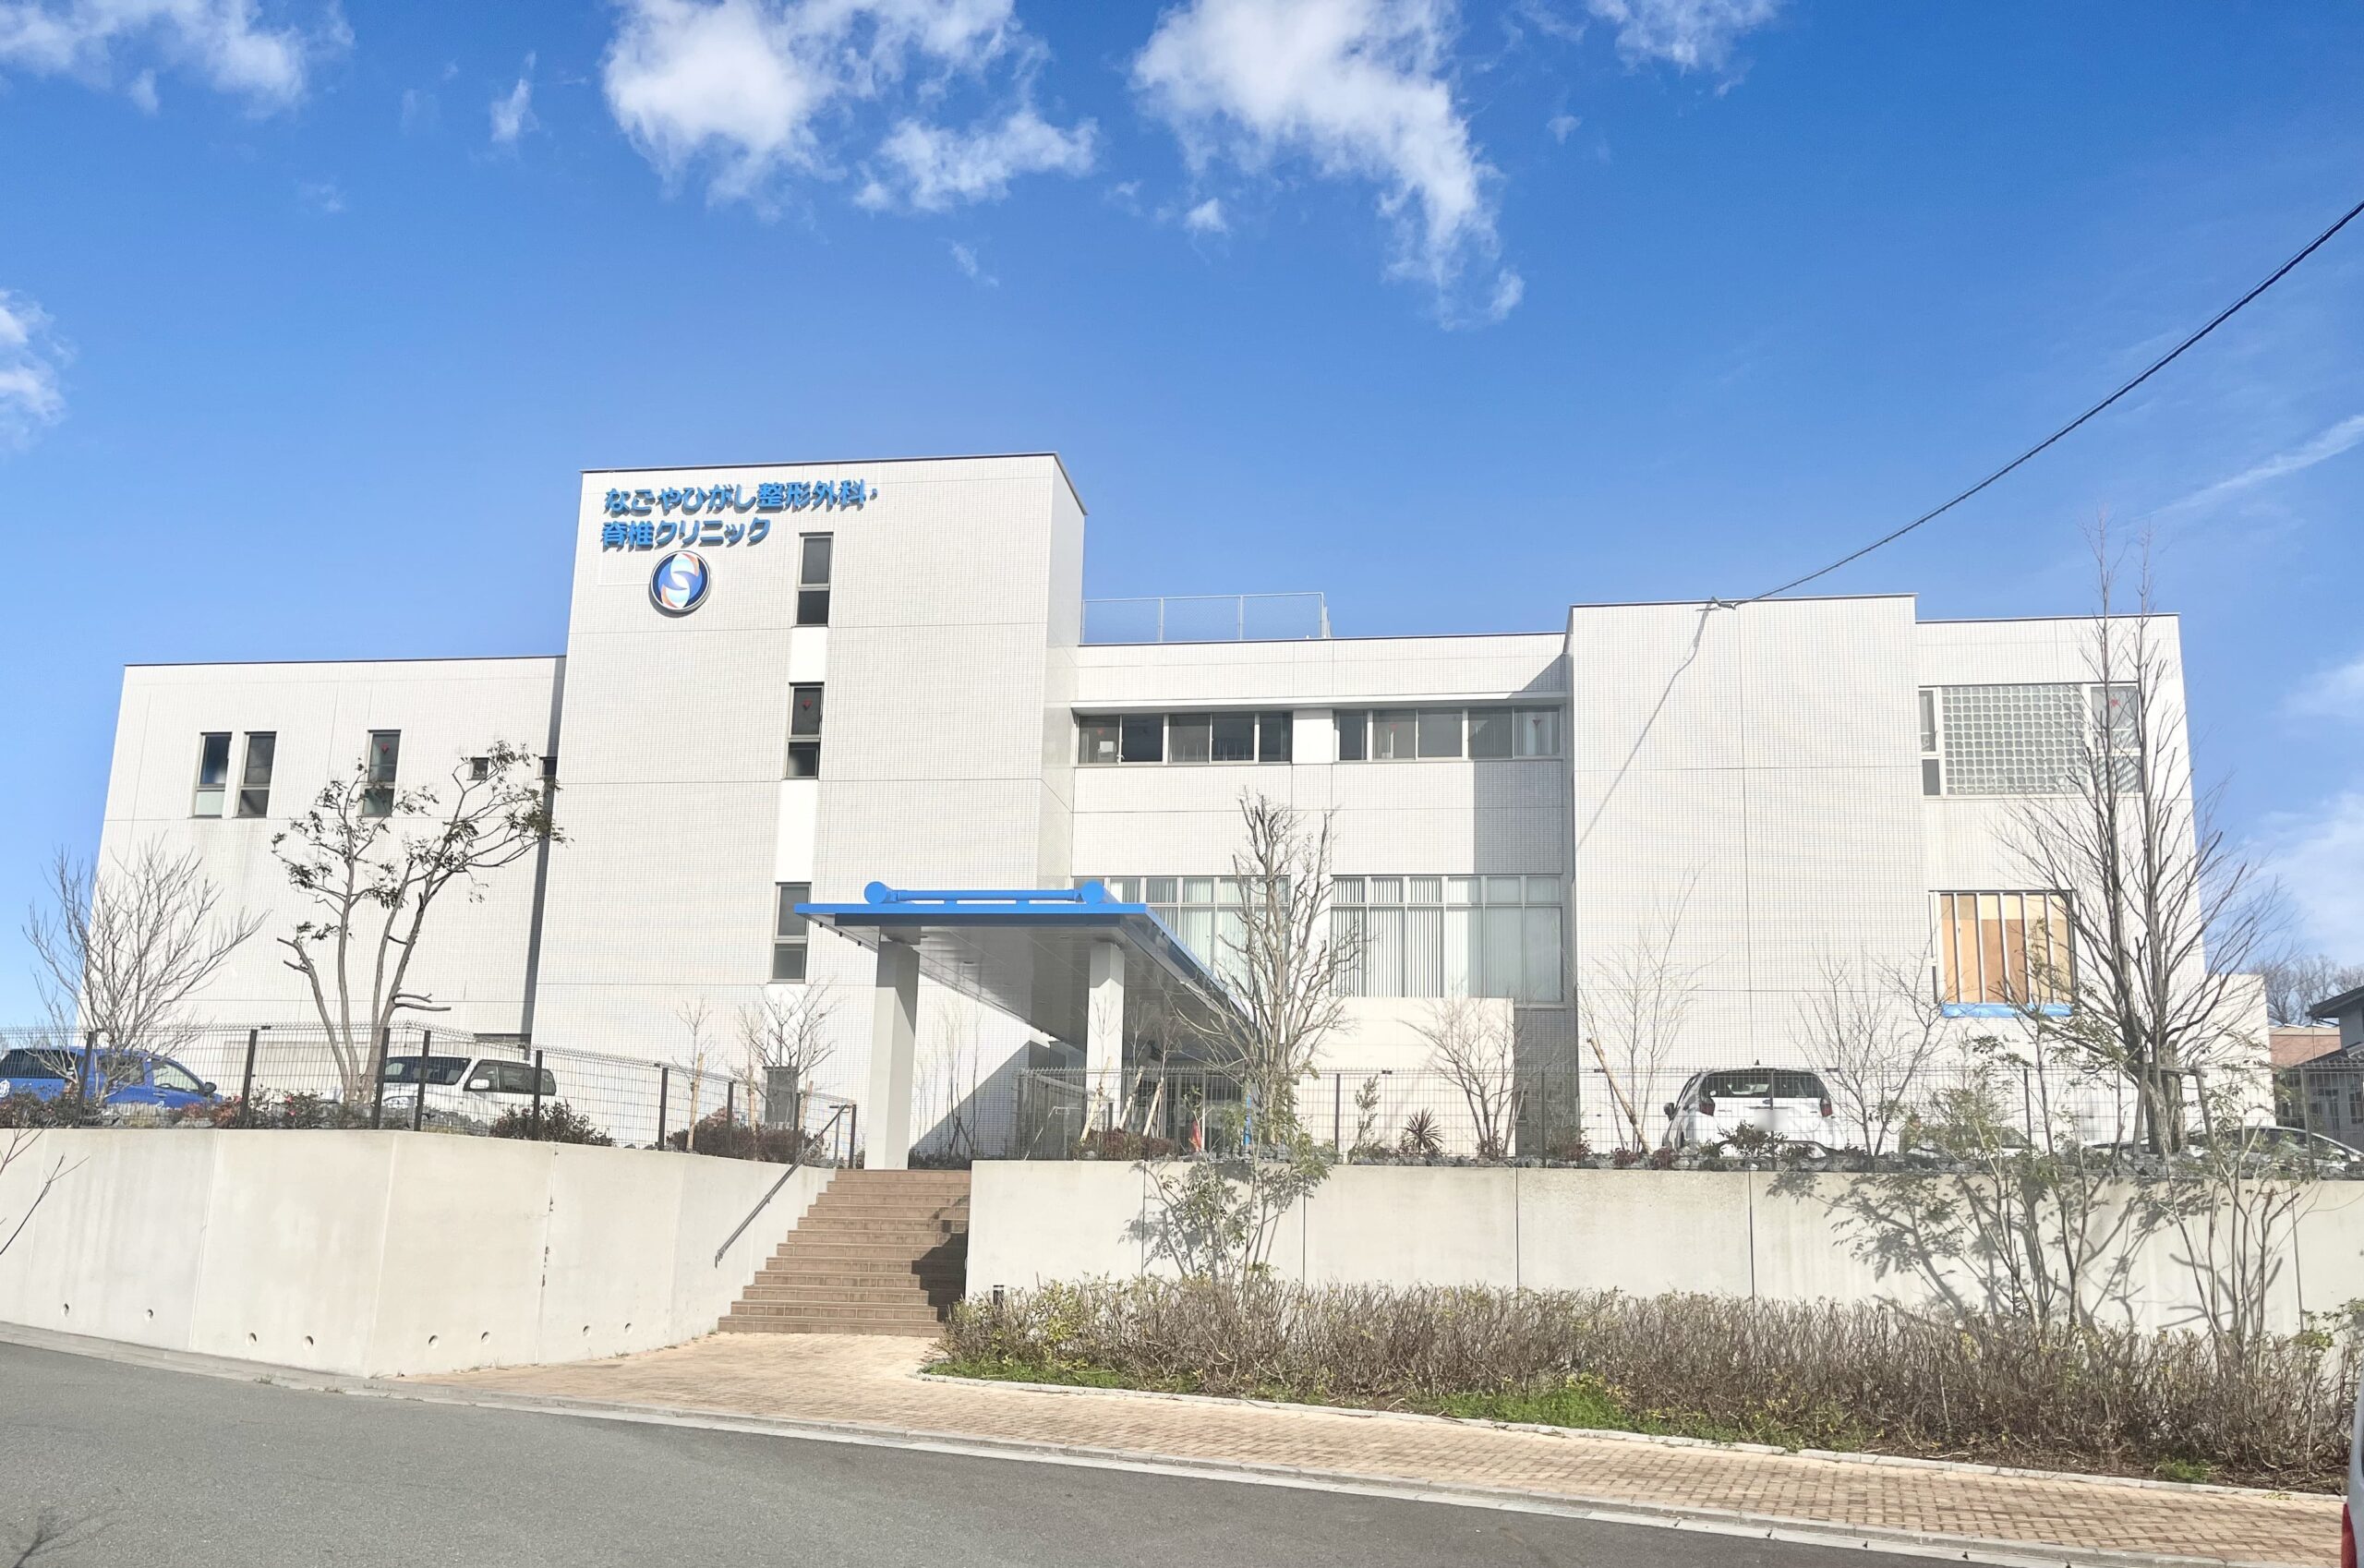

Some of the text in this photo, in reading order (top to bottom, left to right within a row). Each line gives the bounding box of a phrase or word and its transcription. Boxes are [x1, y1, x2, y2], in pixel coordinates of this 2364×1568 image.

[602, 517, 770, 550] 脊椎クリニック
